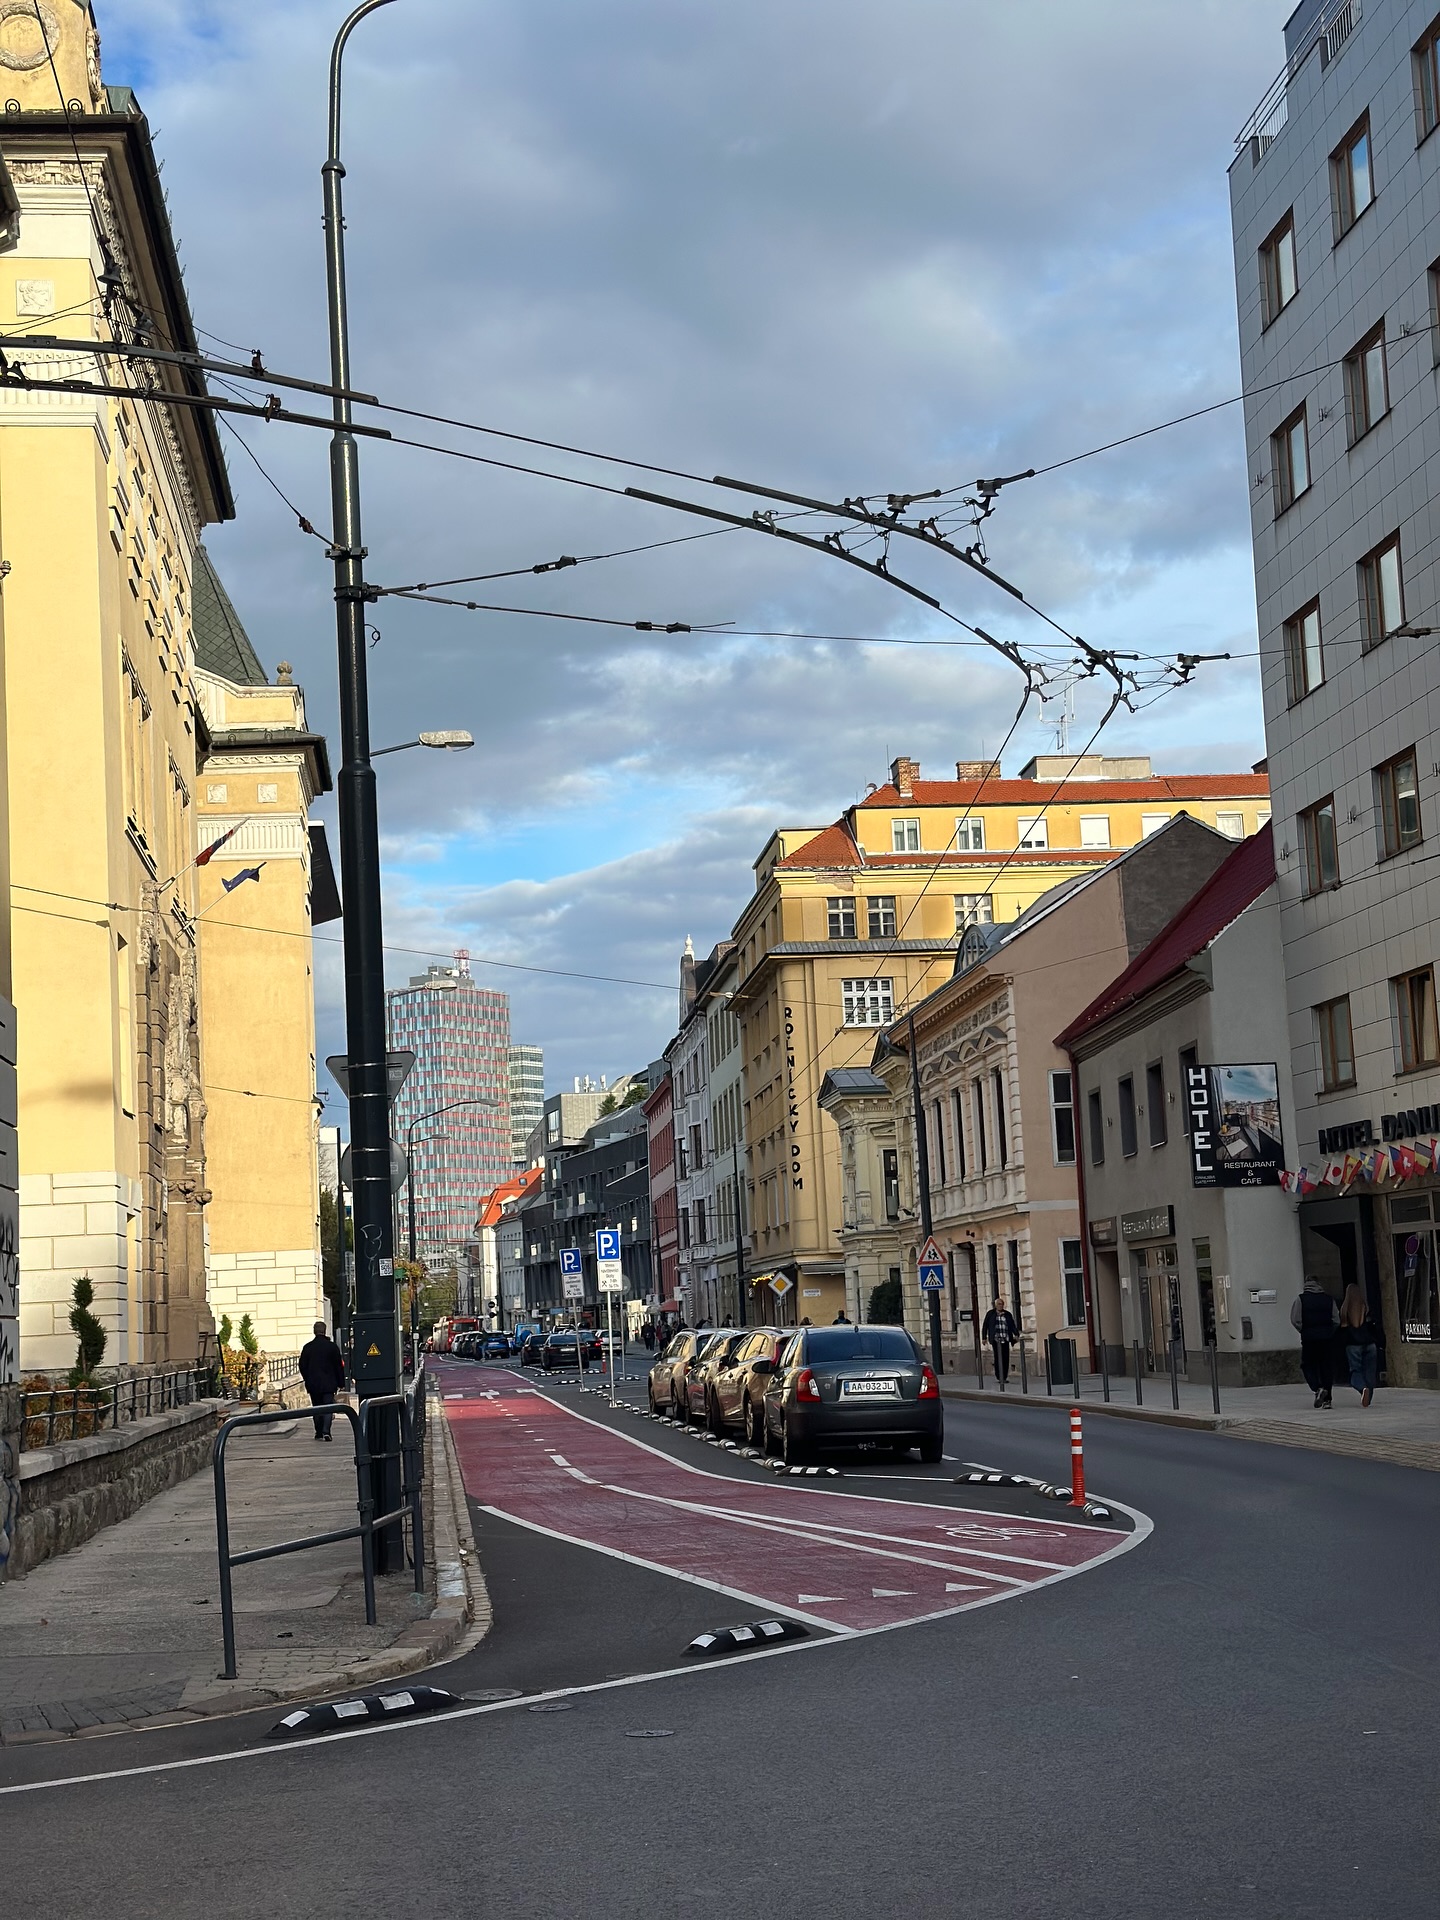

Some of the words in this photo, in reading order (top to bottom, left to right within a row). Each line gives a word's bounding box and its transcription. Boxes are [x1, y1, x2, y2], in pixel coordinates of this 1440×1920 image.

[1188, 1067, 1213, 1172] HOTEL
[1318, 1119, 1380, 1154] HOTEL
[1381, 1103, 1440, 1142] DANU
[792, 1144, 803, 1190] DOM
[1224, 1160, 1276, 1169] RESTAURANT
[1241, 1177, 1262, 1185] CAFE
[600, 1233, 614, 1257] P
[563, 1252, 575, 1271] P
[1405, 1323, 1431, 1335] PARKING
[851, 1383, 863, 1391] AA
